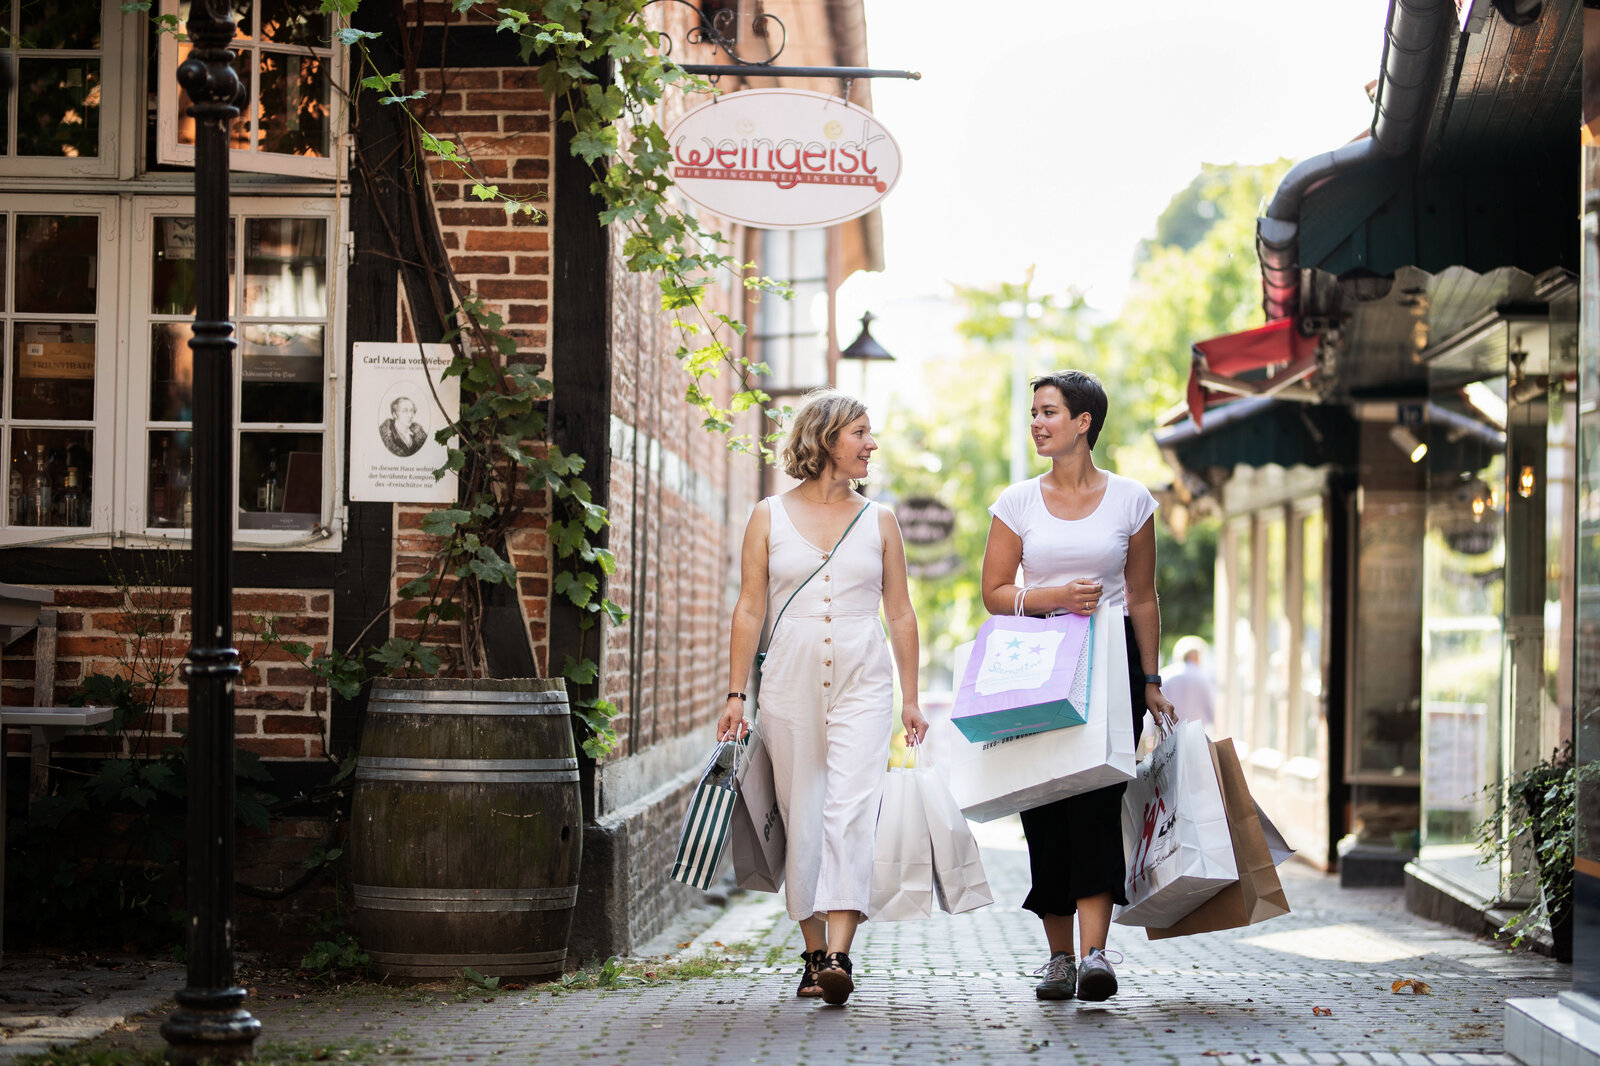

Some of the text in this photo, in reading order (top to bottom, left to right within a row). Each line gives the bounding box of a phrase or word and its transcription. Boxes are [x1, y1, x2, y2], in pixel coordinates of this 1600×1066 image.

[676, 168, 700, 178] WIR
[706, 170, 764, 180] BRINGEN
[806, 174, 829, 183] INS
[834, 176, 875, 185] LEBEN
[363, 355, 451, 366] Carl Maria von Weber
